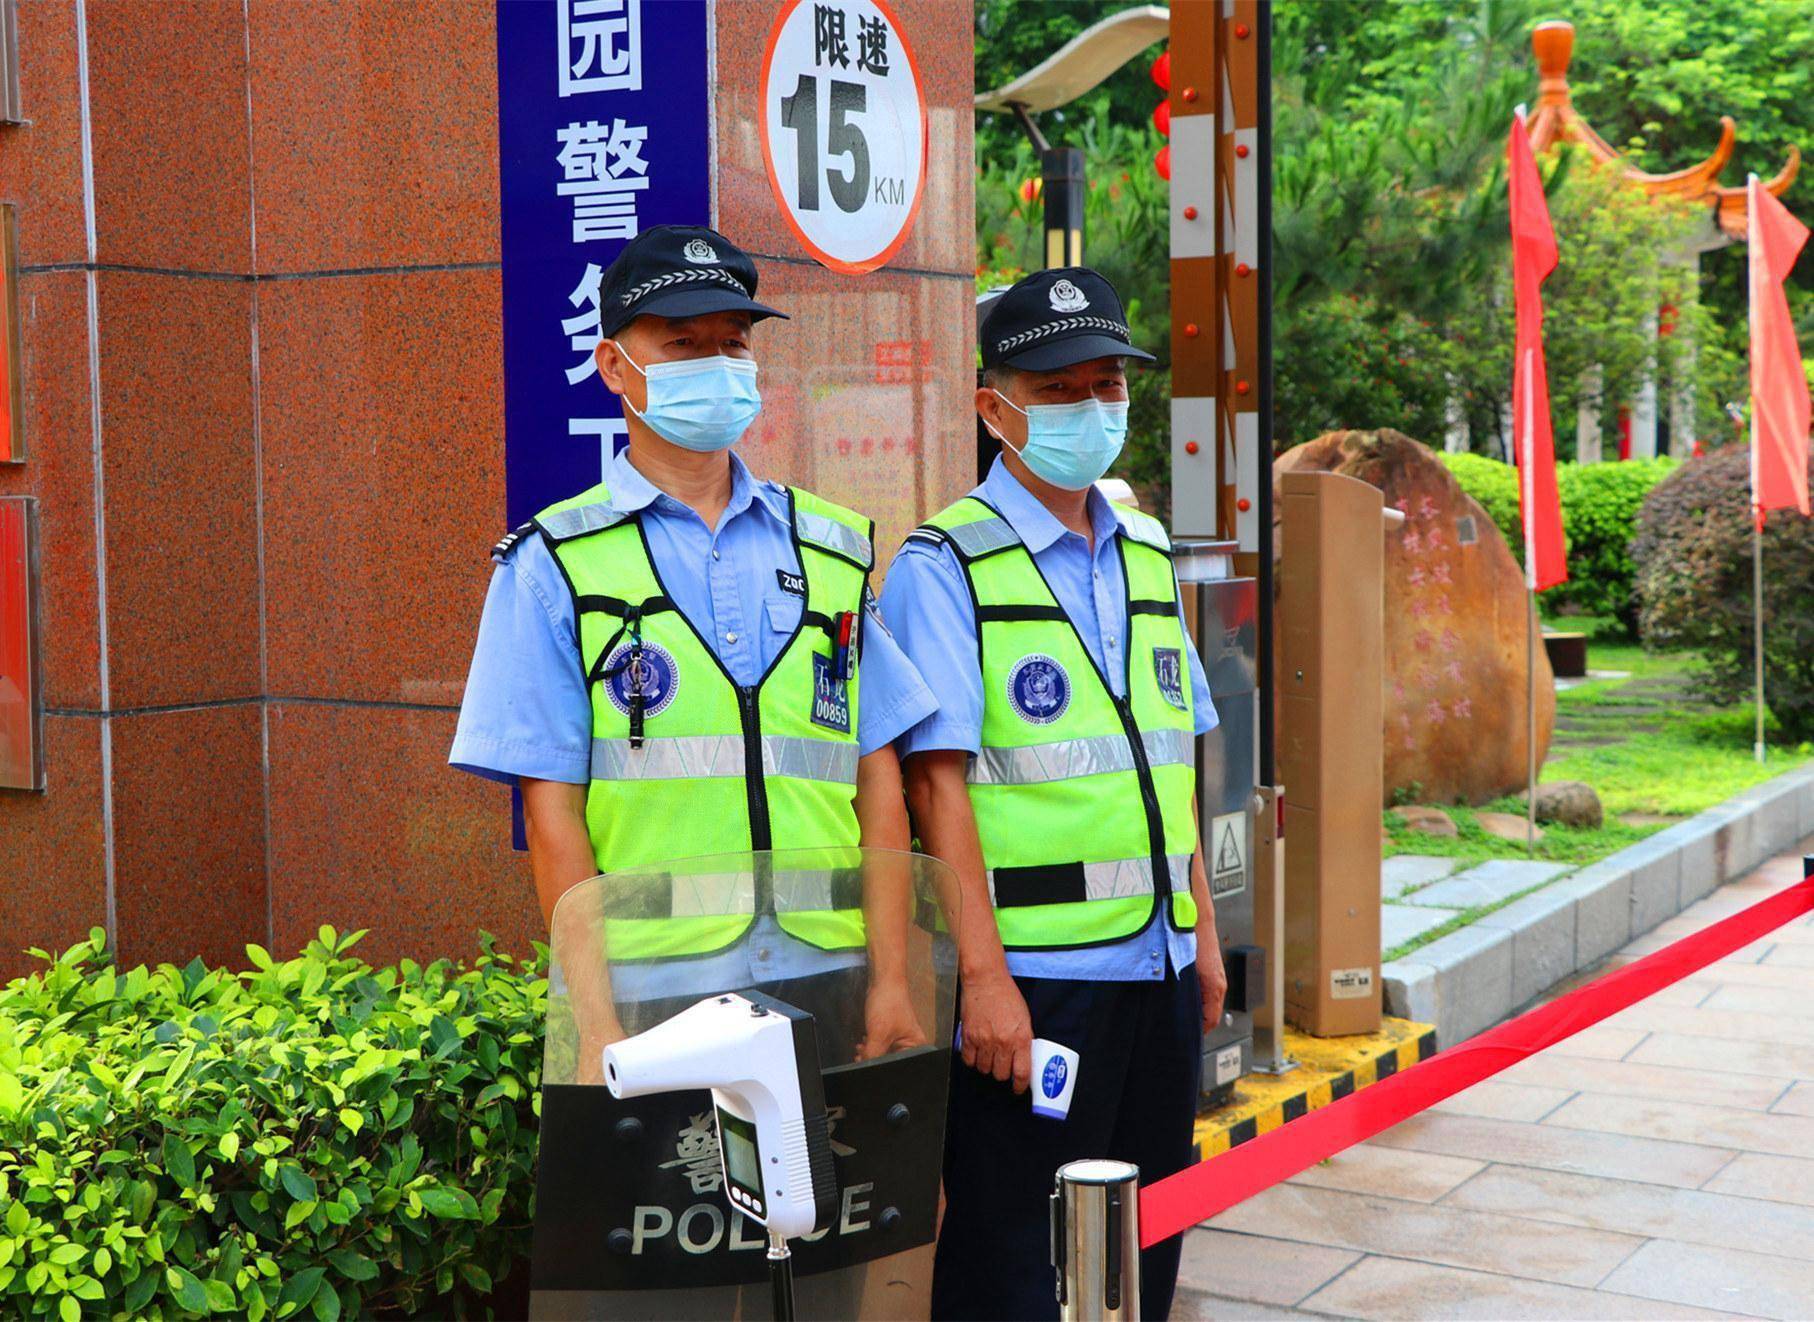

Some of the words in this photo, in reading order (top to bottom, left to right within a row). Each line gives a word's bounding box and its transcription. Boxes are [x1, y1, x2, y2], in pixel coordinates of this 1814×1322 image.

[814, 3, 890, 77] 限速
[781, 73, 871, 214] 15
[875, 176, 905, 206] KM
[816, 699, 847, 726] 00859
[631, 1181, 874, 1256] POLE
